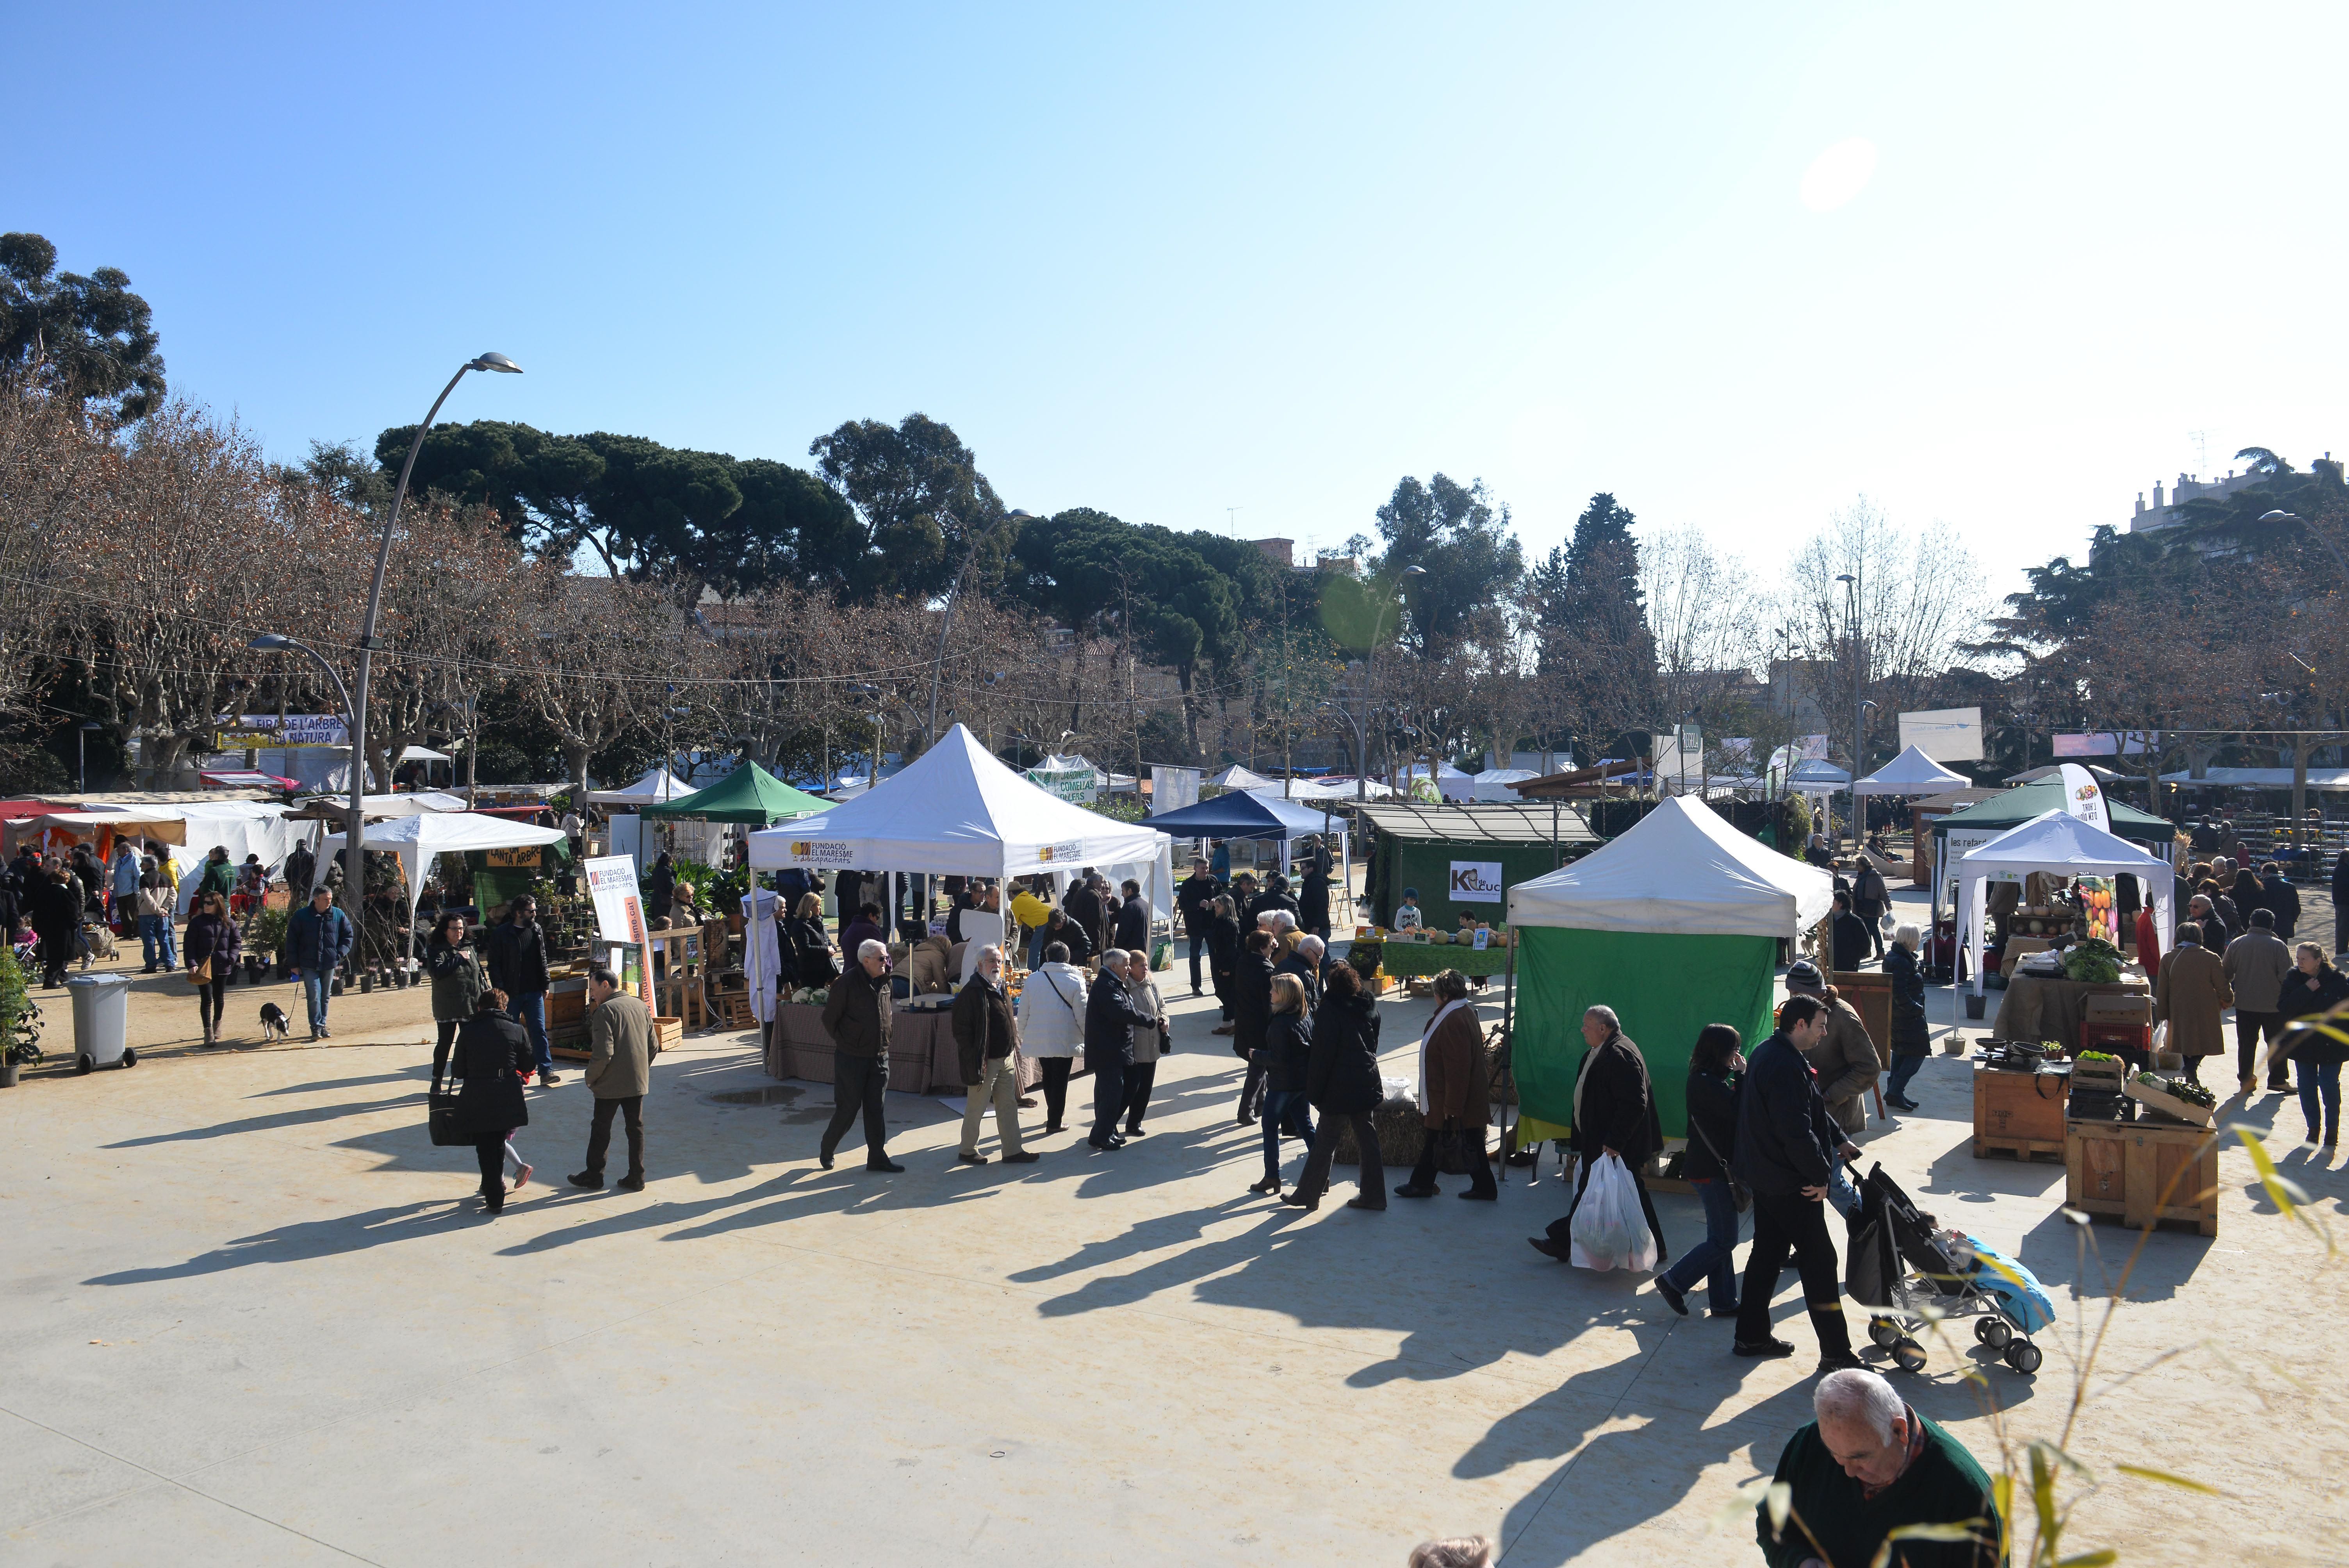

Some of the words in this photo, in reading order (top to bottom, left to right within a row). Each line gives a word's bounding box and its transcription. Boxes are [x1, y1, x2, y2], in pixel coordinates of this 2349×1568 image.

[284, 719, 297, 730] DE
[299, 717, 342, 730] L'ARBRE
[289, 731, 332, 744] NATURA
[1061, 770, 1094, 780] JARDINERIA
[1060, 780, 1094, 792] COMELLAS
[1055, 792, 1085, 801] OLLERS
[812, 842, 847, 850] FUNDACIÓ
[1951, 837, 1960, 846] les
[1053, 843, 1076, 853] FUNDACIÓ
[517, 845, 540, 866] ARBRE
[820, 850, 853, 858] MARESME
[1059, 850, 1081, 859] MARESME
[800, 854, 851, 866] discapacitats
[599, 866, 625, 877] FUNDACIÓ
[608, 874, 633, 883] MARESME
[593, 882, 633, 893] discapacitats
